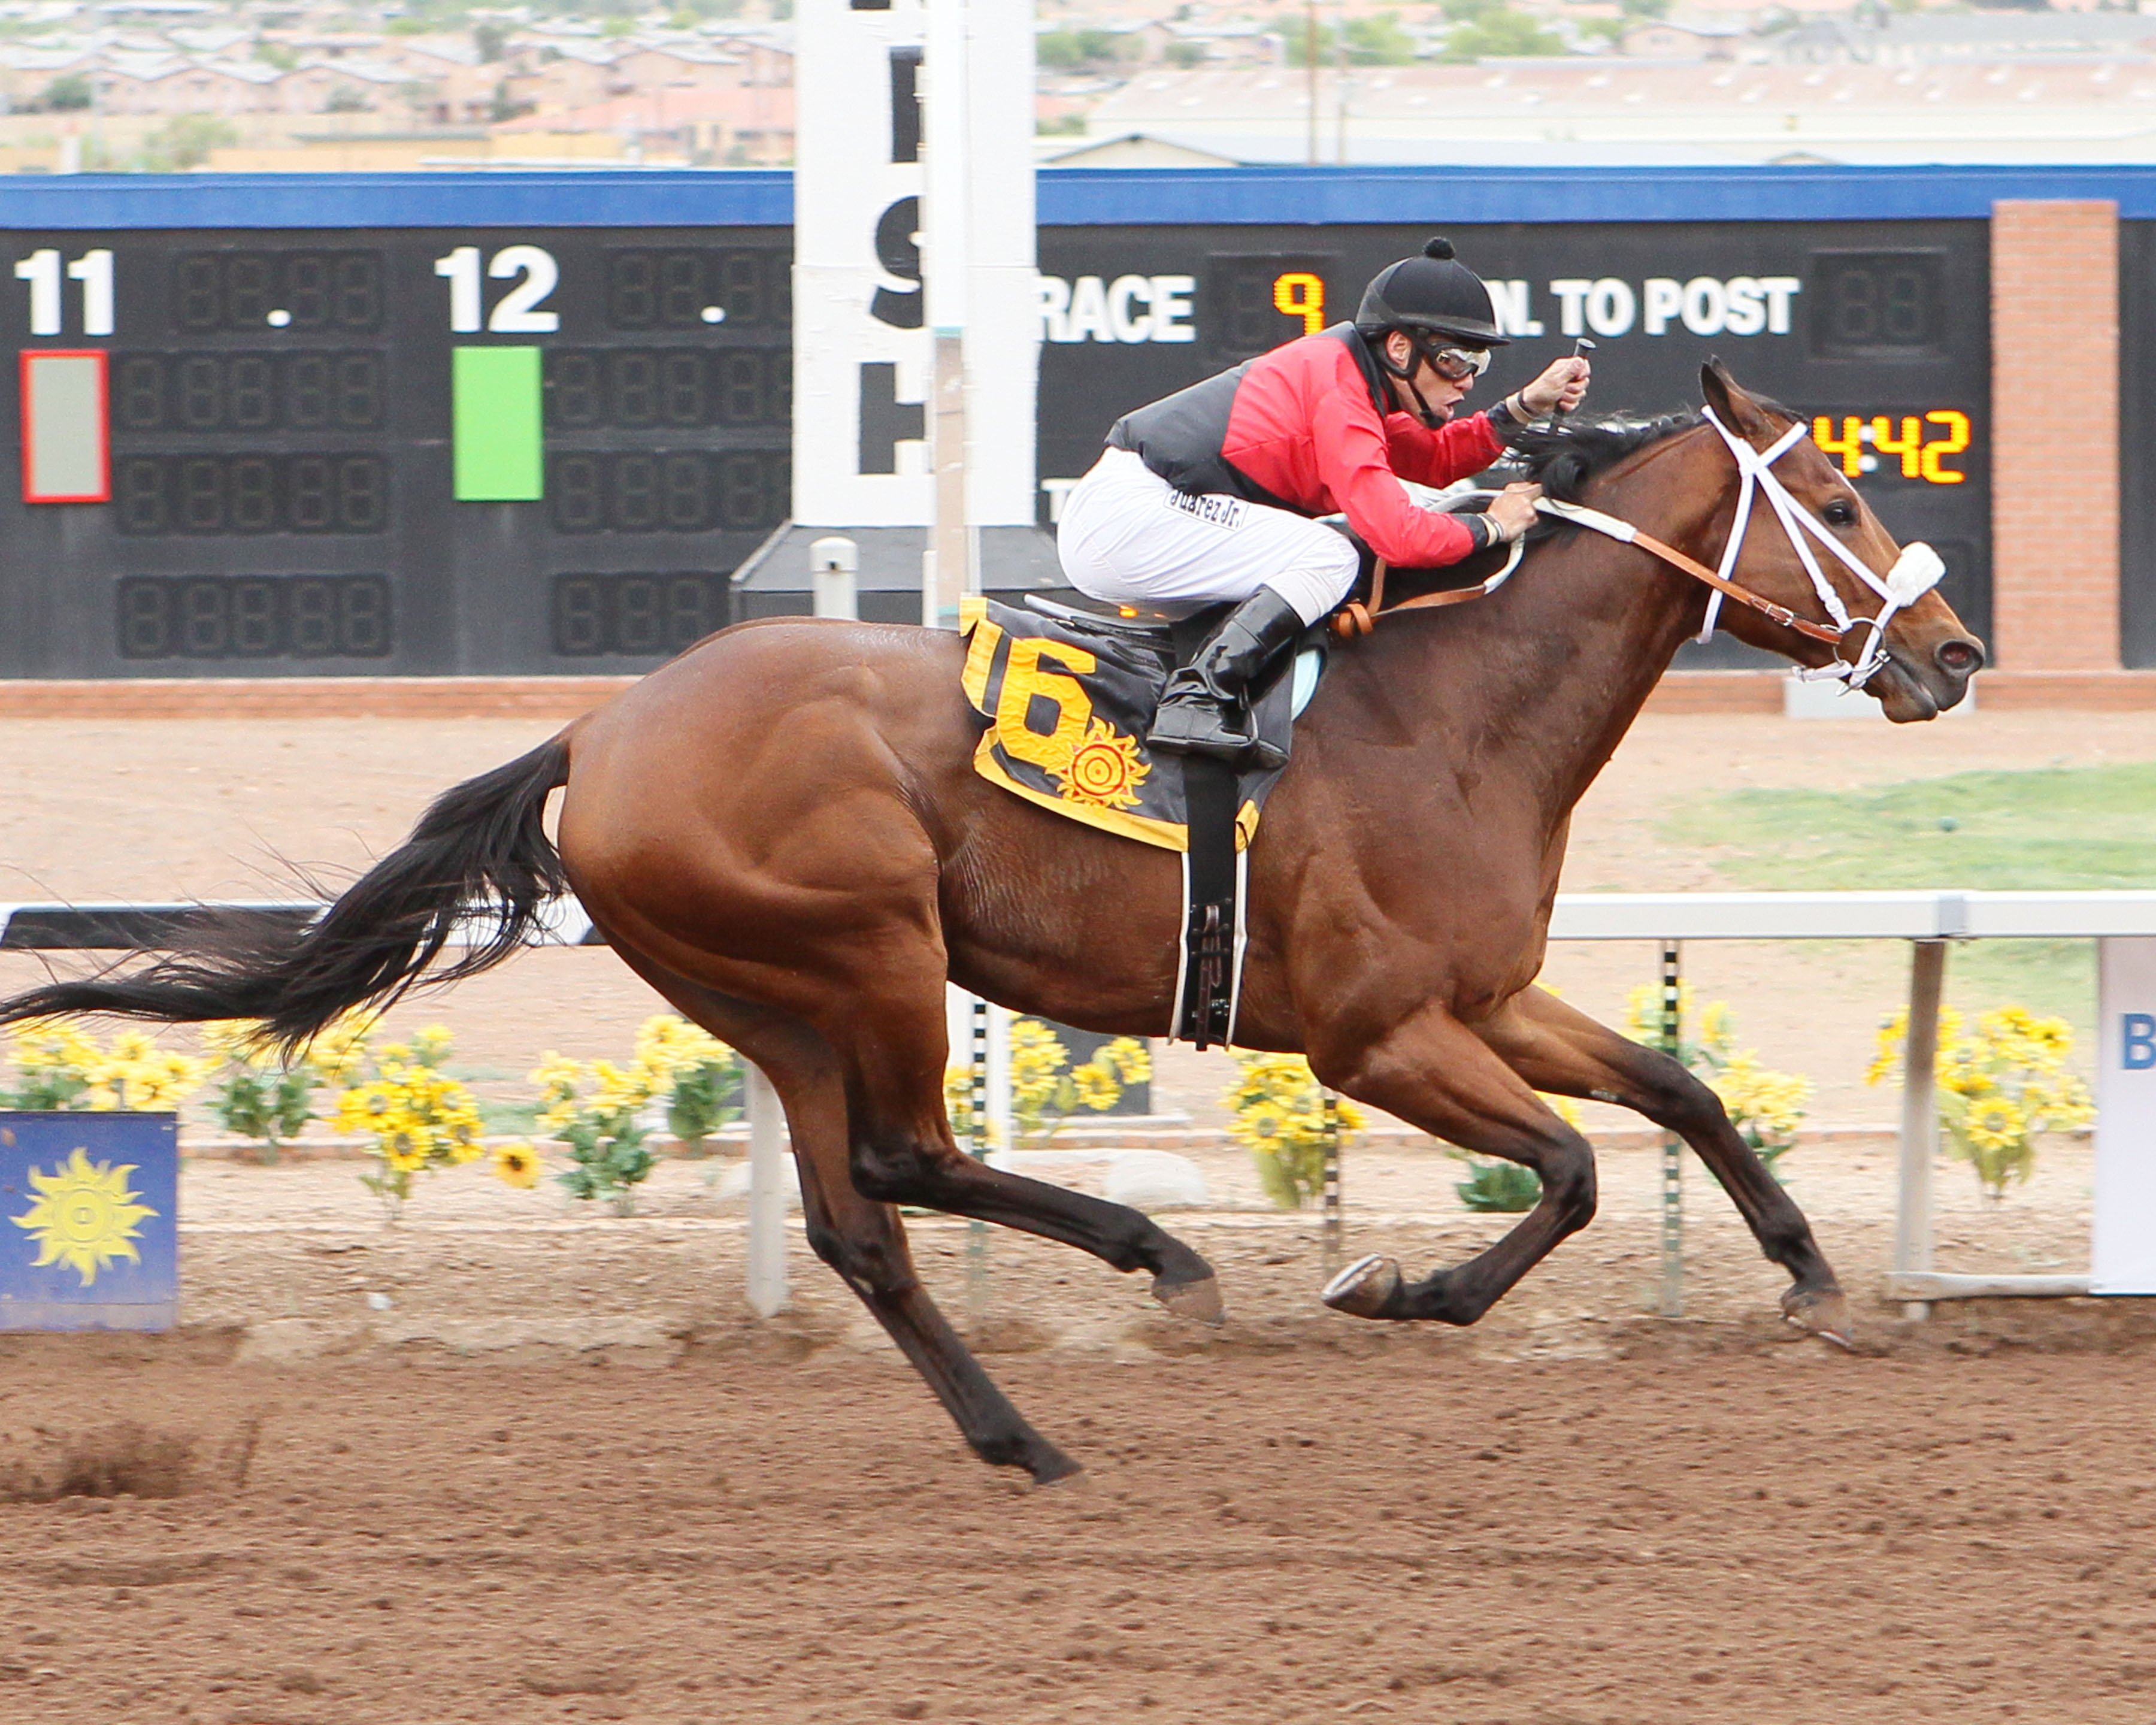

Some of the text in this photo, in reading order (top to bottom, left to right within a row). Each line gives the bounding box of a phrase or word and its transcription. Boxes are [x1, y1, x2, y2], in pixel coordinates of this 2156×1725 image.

[850, 0, 924, 474] ISH
[14, 249, 115, 336] 11
[434, 244, 560, 332] 12
[1034, 274, 1196, 343] RACE
[1273, 272, 1325, 337] 9
[1549, 277, 1636, 338] TO
[1643, 277, 1801, 338] POST
[1812, 410, 1972, 484] 4:42
[996, 637, 1096, 768] 6
